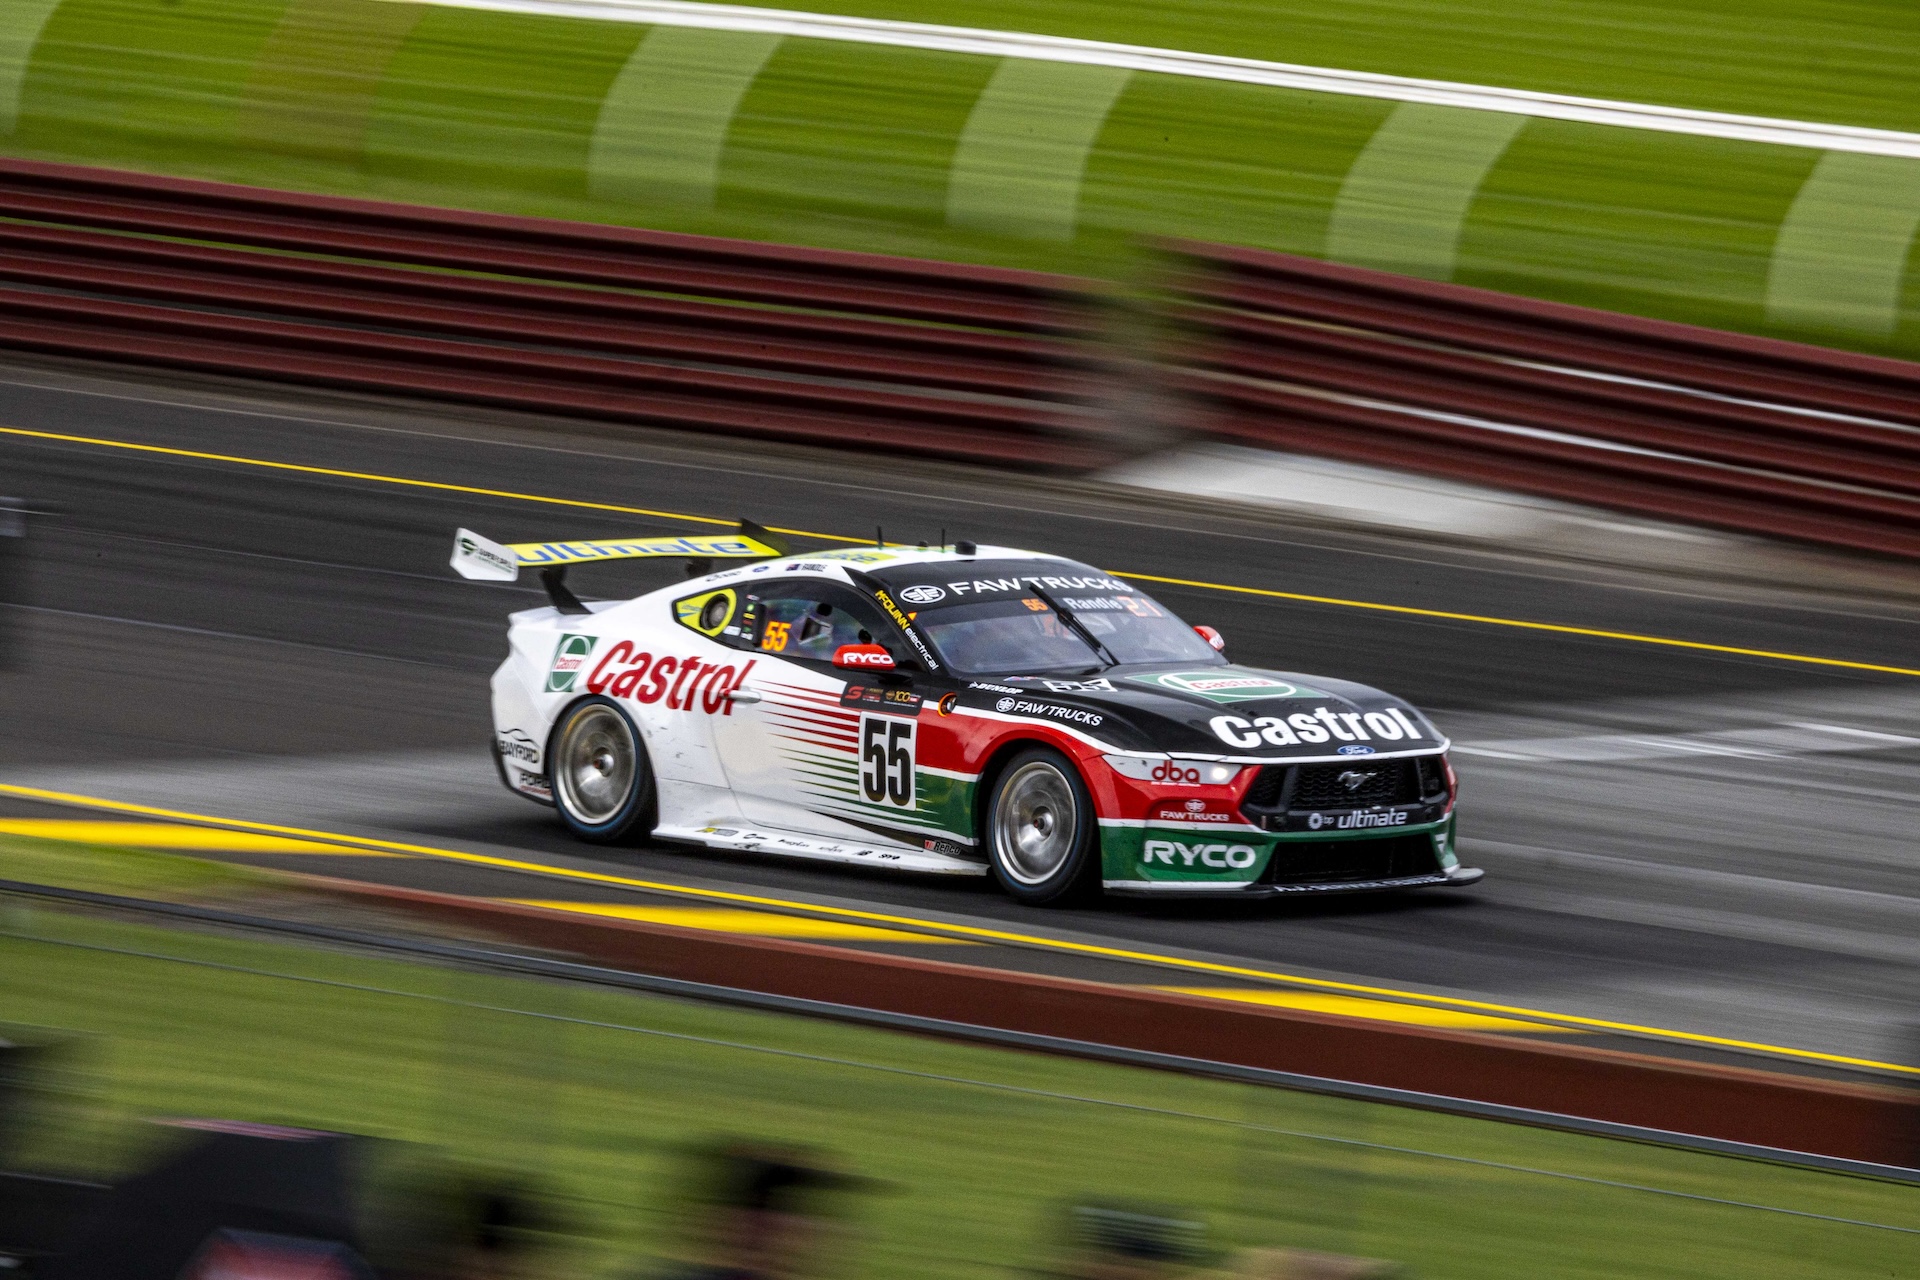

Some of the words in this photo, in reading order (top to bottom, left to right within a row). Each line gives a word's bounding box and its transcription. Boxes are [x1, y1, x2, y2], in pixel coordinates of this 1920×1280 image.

[947, 577, 1023, 596] FAW
[1029, 576, 1134, 593] TRUCKS
[1021, 598, 1048, 611] 55
[1062, 597, 1123, 610] Randle
[761, 620, 791, 653] 55
[843, 652, 894, 666] RYCO
[905, 627, 939, 671] electrical
[586, 639, 758, 716] Castrol
[976, 682, 1024, 695] DUNLOP
[1013, 700, 1049, 716] FAW
[1048, 704, 1104, 727] TRUCKS
[1208, 707, 1423, 749] Castrol
[863, 717, 911, 807] 55
[1152, 760, 1200, 784] dba
[1160, 810, 1186, 820] FAW
[1186, 812, 1229, 822] TRUCKS
[1338, 808, 1407, 829] ultimate
[1144, 840, 1256, 869] RYCO
